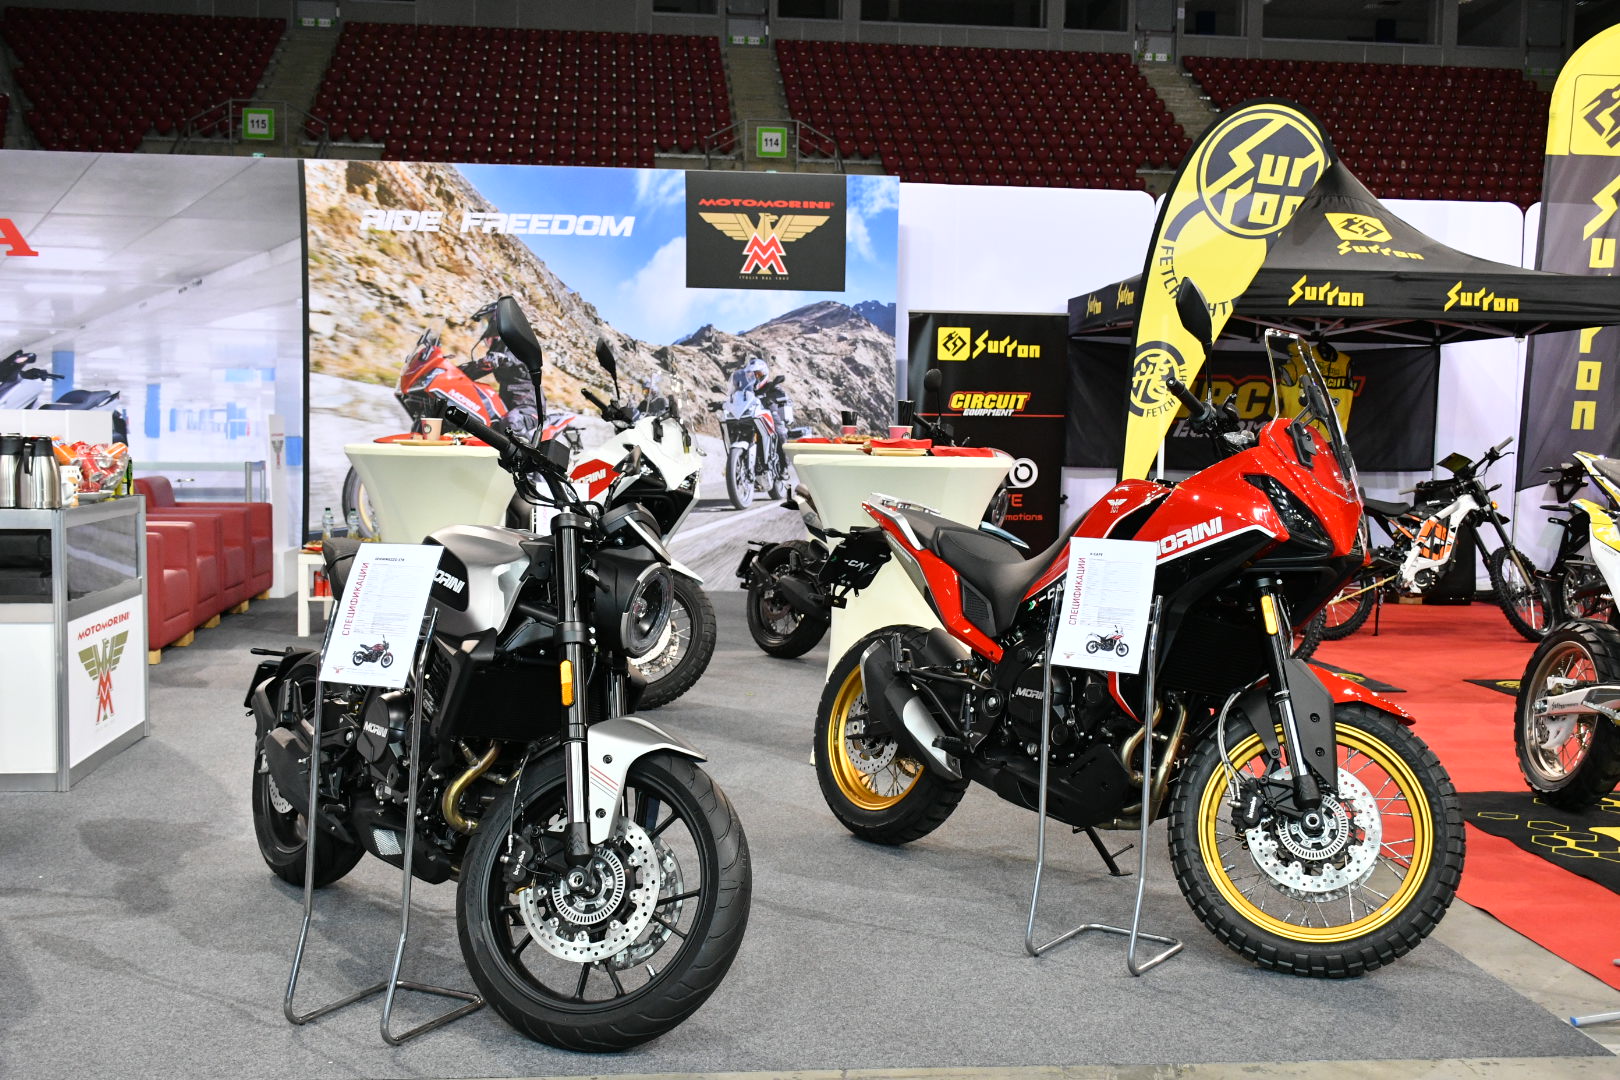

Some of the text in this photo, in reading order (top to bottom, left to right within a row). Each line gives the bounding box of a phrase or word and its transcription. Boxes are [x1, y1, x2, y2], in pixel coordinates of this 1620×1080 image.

[250, 119, 267, 129] 115
[764, 137, 779, 148] 114
[698, 198, 832, 210] MOTOMORINI
[360, 209, 636, 238] RIDE FREEDOM
[1337, 240, 1425, 260] Surron
[1288, 274, 1365, 307] Surron
[1443, 280, 1520, 312] Surron
[972, 329, 1041, 360] Surron
[950, 393, 1029, 410] CIRCUIT
[962, 408, 1015, 417] EQUIPMENT
[1156, 516, 1223, 556] ORINI
[433, 569, 466, 594] ORINI
[1068, 557, 1087, 626] СПЕЦИФИКАЦИИ
[341, 562, 370, 636] СПЕЦИФИКАЦИИ
[77, 611, 131, 641] MOTOMORINI
[363, 720, 389, 738] MORINI
